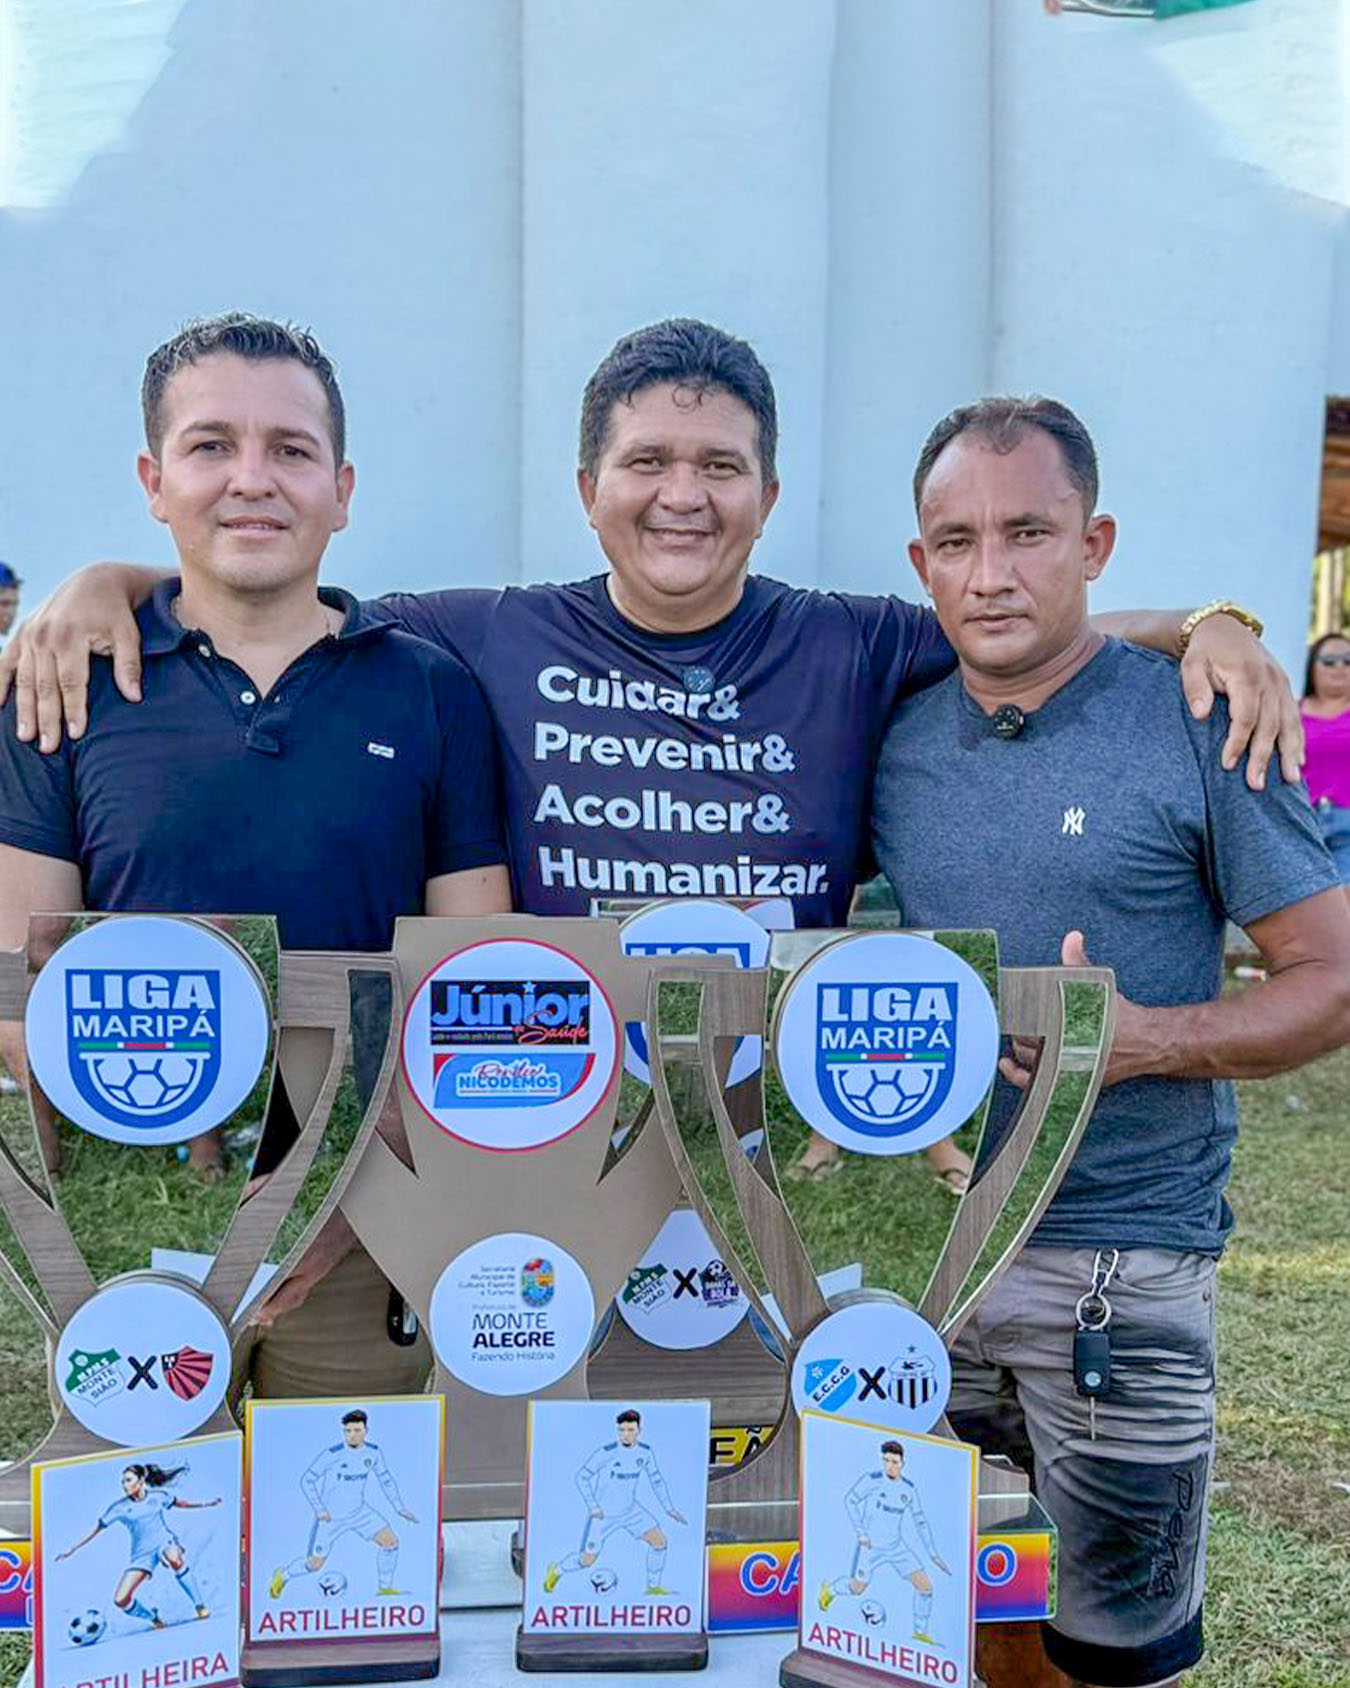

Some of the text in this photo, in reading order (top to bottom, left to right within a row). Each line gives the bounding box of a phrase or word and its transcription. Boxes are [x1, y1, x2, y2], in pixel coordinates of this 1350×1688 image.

[534, 721, 796, 772] Prevenir&
[533, 784, 790, 834] Acolher&
[537, 846, 829, 896] Humanizar.
[70, 974, 216, 1010] LIGA
[431, 981, 590, 1026] Júnior
[821, 987, 953, 1022] LIGA
[72, 1010, 216, 1038] MARIPÁ
[821, 1020, 951, 1050] MARIPÁ
[459, 1075, 559, 1089] NICODEMOS
[472, 1312, 549, 1330] MONTE
[472, 1331, 556, 1349] ALEGRE
[77, 1367, 117, 1396] MONTE
[258, 1604, 426, 1634] ARTILHEIRO
[531, 1605, 692, 1628] ARTILHEIRO
[808, 1622, 959, 1685] ARTILHEIRO
